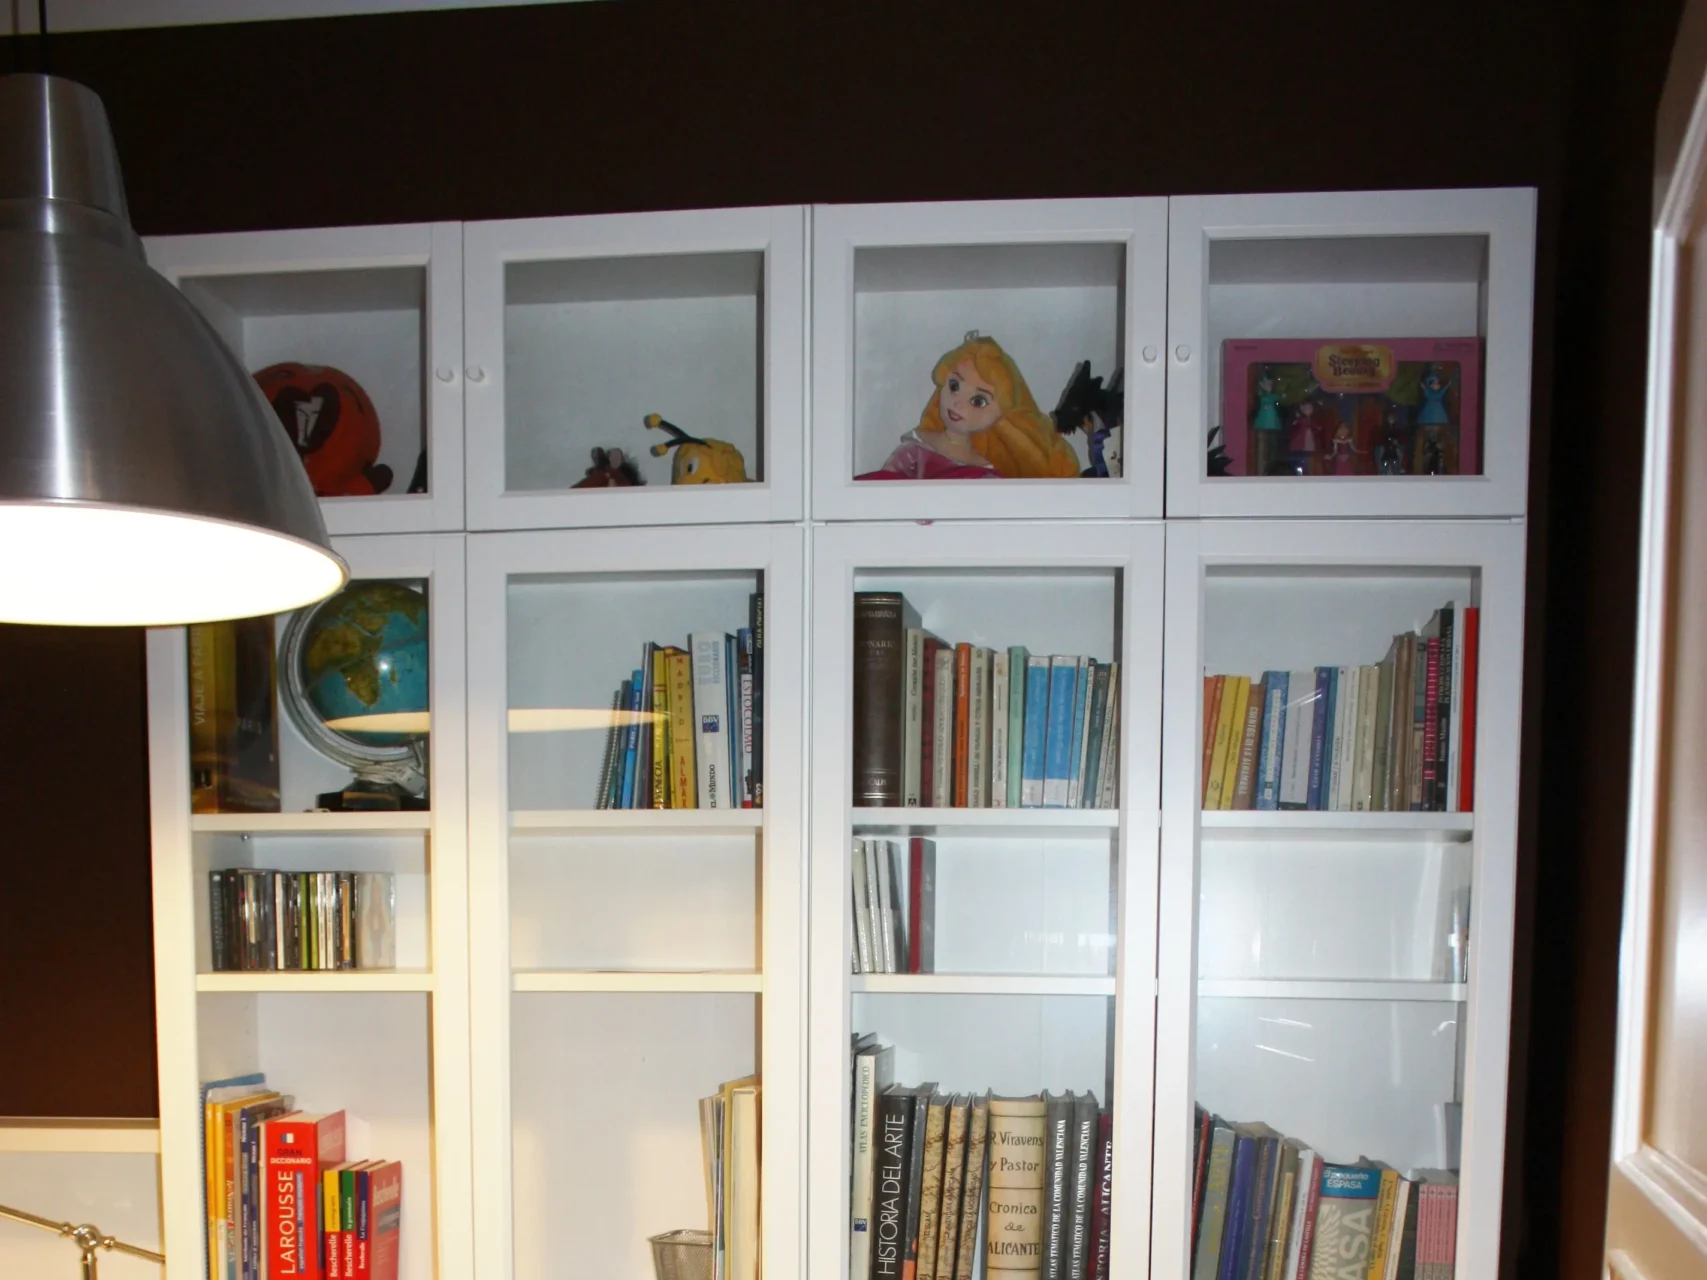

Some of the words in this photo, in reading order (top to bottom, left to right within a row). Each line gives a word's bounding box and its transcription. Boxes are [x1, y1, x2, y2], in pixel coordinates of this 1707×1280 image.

[193, 685, 206, 725] VIAJE
[743, 679, 753, 755] ESTOCOLMO
[708, 764, 717, 794] MUNDO
[1238, 757, 1252, 796] ALHAMBRA
[277, 1148, 303, 1156] GRAN
[859, 1130, 869, 1155] ATLAS
[884, 1114, 905, 1158] ARTE
[1055, 1119, 1067, 1161] VALENCIANA
[1079, 1121, 1091, 1162] VALENCIANA
[270, 1157, 312, 1165] DICCIONARIO
[1000, 1156, 1040, 1172] Pastor
[883, 1162, 902, 1194] DEL
[1052, 1162, 1064, 1202] COMUNIDAD
[1076, 1163, 1088, 1203] COMUNIDAD
[1327, 1179, 1362, 1189] ESPASA
[278, 1169, 296, 1275] LAROUSSE
[989, 1202, 1038, 1215] Cronica
[877, 1198, 899, 1275] HISTORIA
[1004, 1221, 1026, 1233] de
[1050, 1224, 1060, 1258] TEMATICO
[1073, 1225, 1084, 1258] TEMATICO
[329, 1234, 338, 1278] Bescherelle
[344, 1234, 353, 1277] Bescherelle
[988, 1242, 1040, 1256] ALICANTE
[1049, 1259, 1058, 1279] ATLAS
[1072, 1260, 1081, 1280] ATLAS
